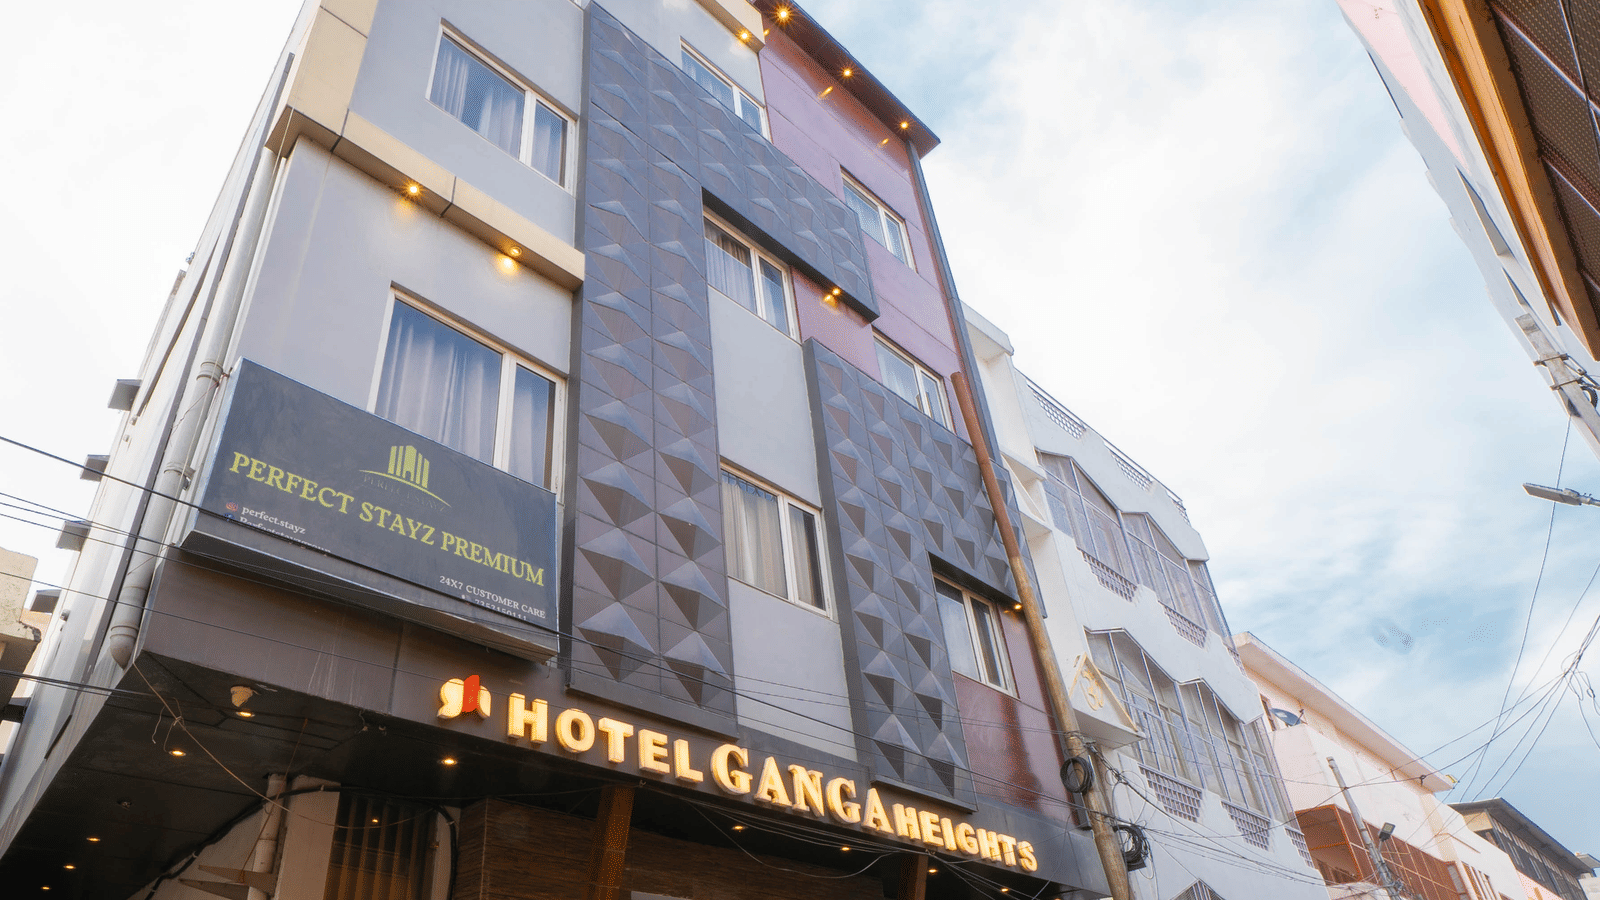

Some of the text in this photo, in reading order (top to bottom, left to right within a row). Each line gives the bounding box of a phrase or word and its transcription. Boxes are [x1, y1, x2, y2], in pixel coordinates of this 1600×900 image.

[229, 451, 354, 514] PERFECT
[359, 501, 435, 546] STAYZ
[440, 530, 545, 586] PREMIUM
[241, 506, 306, 534] perfect.stayz
[440, 575, 547, 619] 24X7 CUSTOMER CARE
[507, 693, 1038, 872] HOTEL GANGA HEIGHTS
